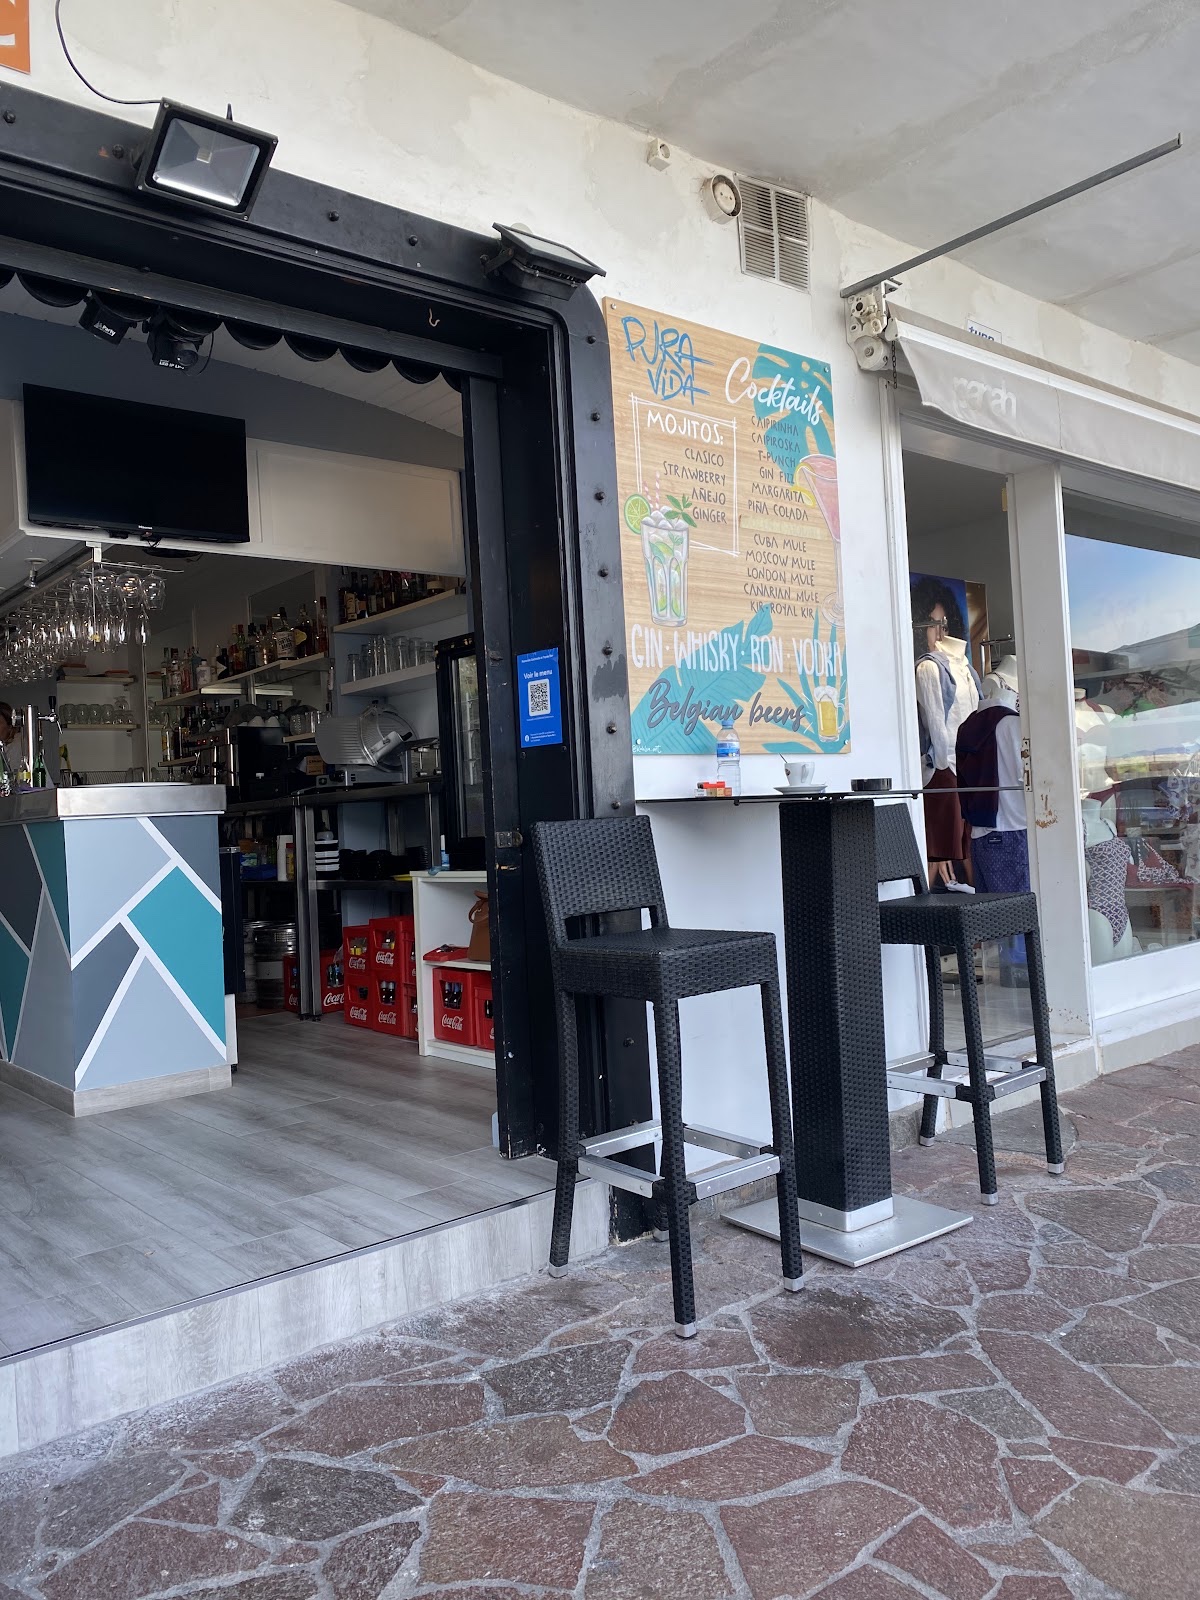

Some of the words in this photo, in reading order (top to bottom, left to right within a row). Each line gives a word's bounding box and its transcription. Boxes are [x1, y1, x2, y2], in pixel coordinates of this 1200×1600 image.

[621, 315, 715, 381] PURA
[725, 357, 824, 426] Cocktails
[647, 409, 724, 446] MOJITOS:
[751, 415, 799, 437] CAIPIRINHA
[751, 432, 801, 454] CAIPIROSKA
[684, 447, 724, 467] CLASICO
[758, 449, 796, 468] T-PUNCH
[663, 460, 726, 485] STRAWBERRY
[759, 466, 774, 481] GIN
[779, 469, 795, 484] FIZZ
[692, 486, 726, 506] AÑEJO
[751, 482, 805, 504] MARGARITA
[692, 506, 727, 525] GINGER
[748, 499, 769, 516] PIÑA
[773, 504, 809, 521] COLADA
[753, 533, 778, 549] CUBA
[783, 539, 807, 553] MULE
[745, 549, 789, 567] MOSCOW
[791, 557, 816, 571] MULE
[747, 567, 786, 584] LONDON
[790, 573, 815, 587] MULE
[743, 583, 791, 600] CANARIAN
[796, 592, 820, 604] MULE
[750, 600, 765, 613] KIR
[770, 603, 798, 617] ROYAL
[800, 606, 815, 620] KIR
[631, 623, 664, 669] GIN
[673, 630, 740, 673] WHISKY
[750, 634, 784, 674] RON
[792, 637, 844, 677] VODKA
[539, 669, 553, 677] menu
[647, 678, 744, 736] Belgian
[749, 692, 807, 732] beers
